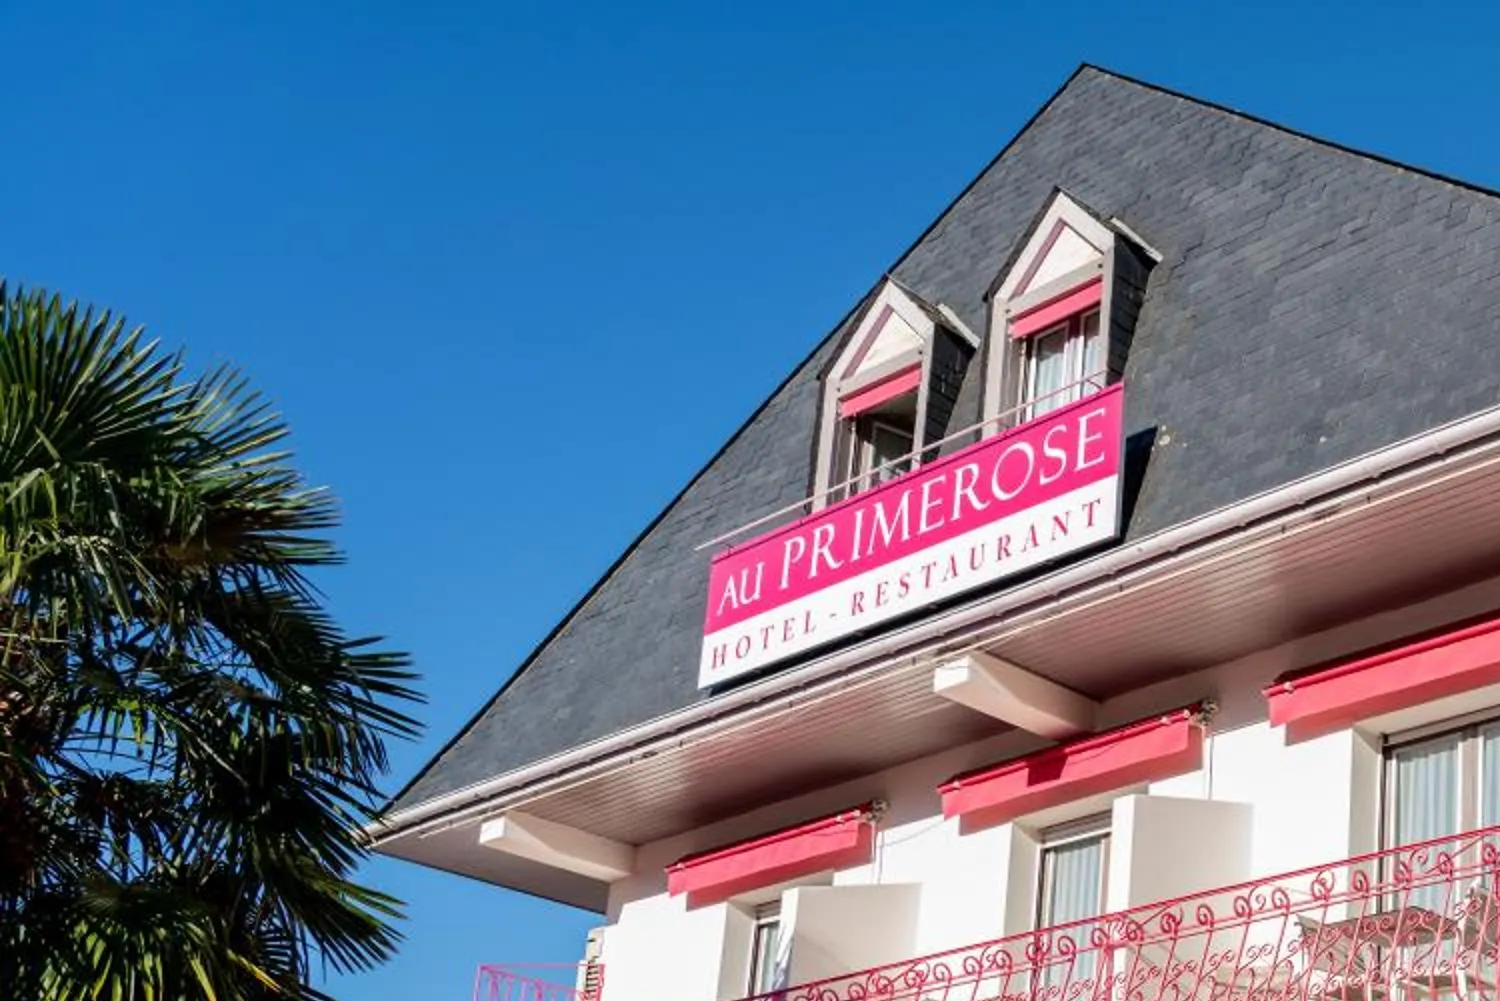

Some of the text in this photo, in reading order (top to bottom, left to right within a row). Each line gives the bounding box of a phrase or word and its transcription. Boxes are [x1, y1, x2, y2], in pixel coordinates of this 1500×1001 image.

[711, 611, 817, 671] HOTEL
[851, 499, 1102, 617] RESTAURANT
[717, 408, 1106, 616] AU PRIMEROSE
